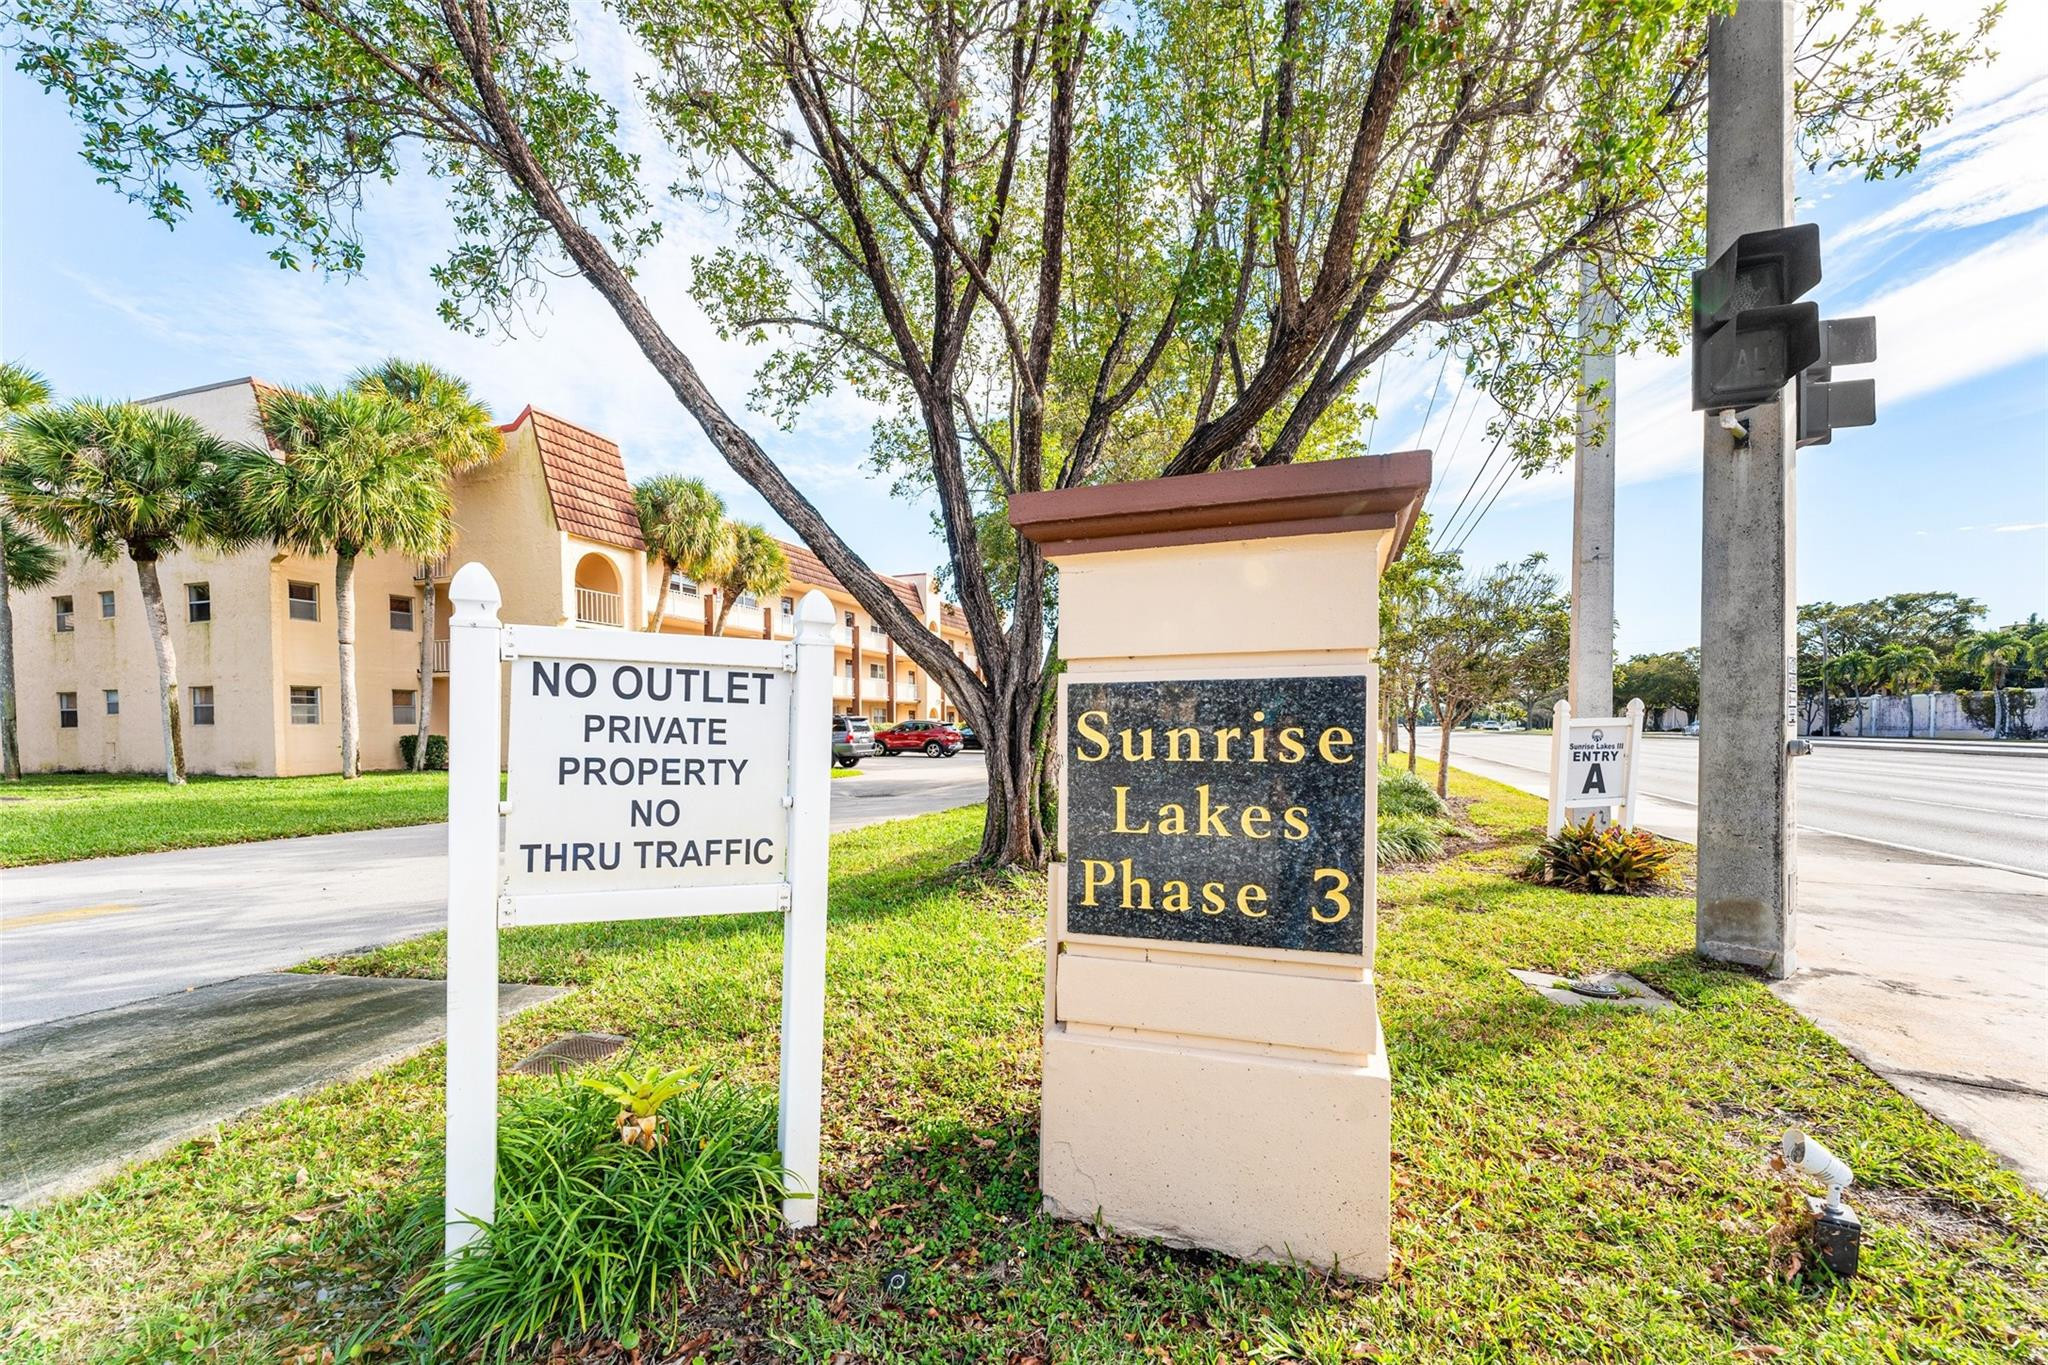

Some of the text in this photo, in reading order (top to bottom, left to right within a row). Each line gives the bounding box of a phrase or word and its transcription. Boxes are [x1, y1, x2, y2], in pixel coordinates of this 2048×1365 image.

[532, 661, 775, 705] NO OUTLET
[584, 714, 727, 745] PRIVATE
[1076, 710, 1354, 764] Sunrise
[558, 757, 749, 786] PROPERTY
[1573, 750, 1619, 762] ENTRY
[1581, 763, 1606, 794] A
[630, 799, 681, 827] NO
[1111, 784, 1310, 840] Lakes
[519, 838, 774, 873] THRU TRAFFIC
[1080, 858, 1351, 923] Phase 3
